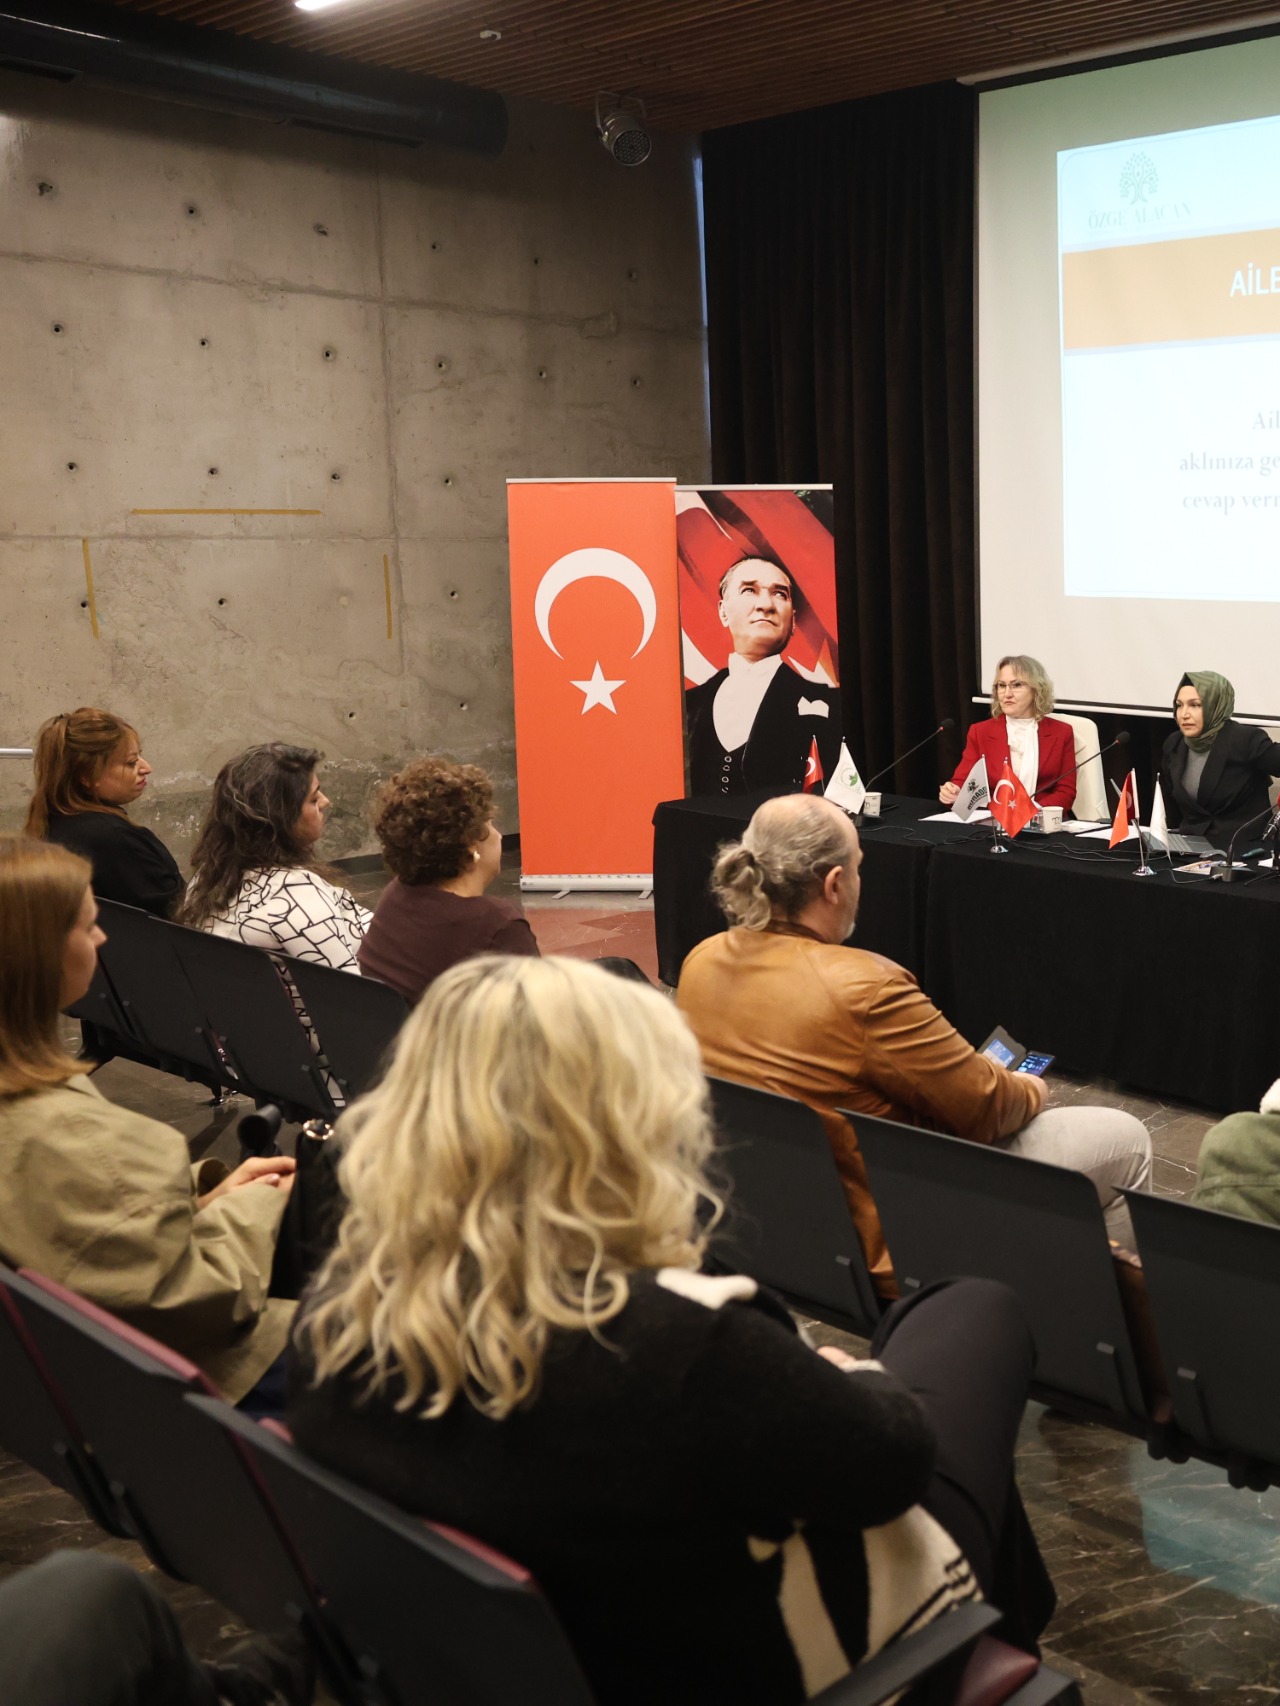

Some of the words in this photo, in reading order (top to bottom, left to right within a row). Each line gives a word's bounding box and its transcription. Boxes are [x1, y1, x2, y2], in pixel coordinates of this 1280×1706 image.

[1088, 209, 1128, 229] ÖZGE
[1179, 452, 1255, 471] aklınıza
[1182, 493, 1235, 515] cevap
